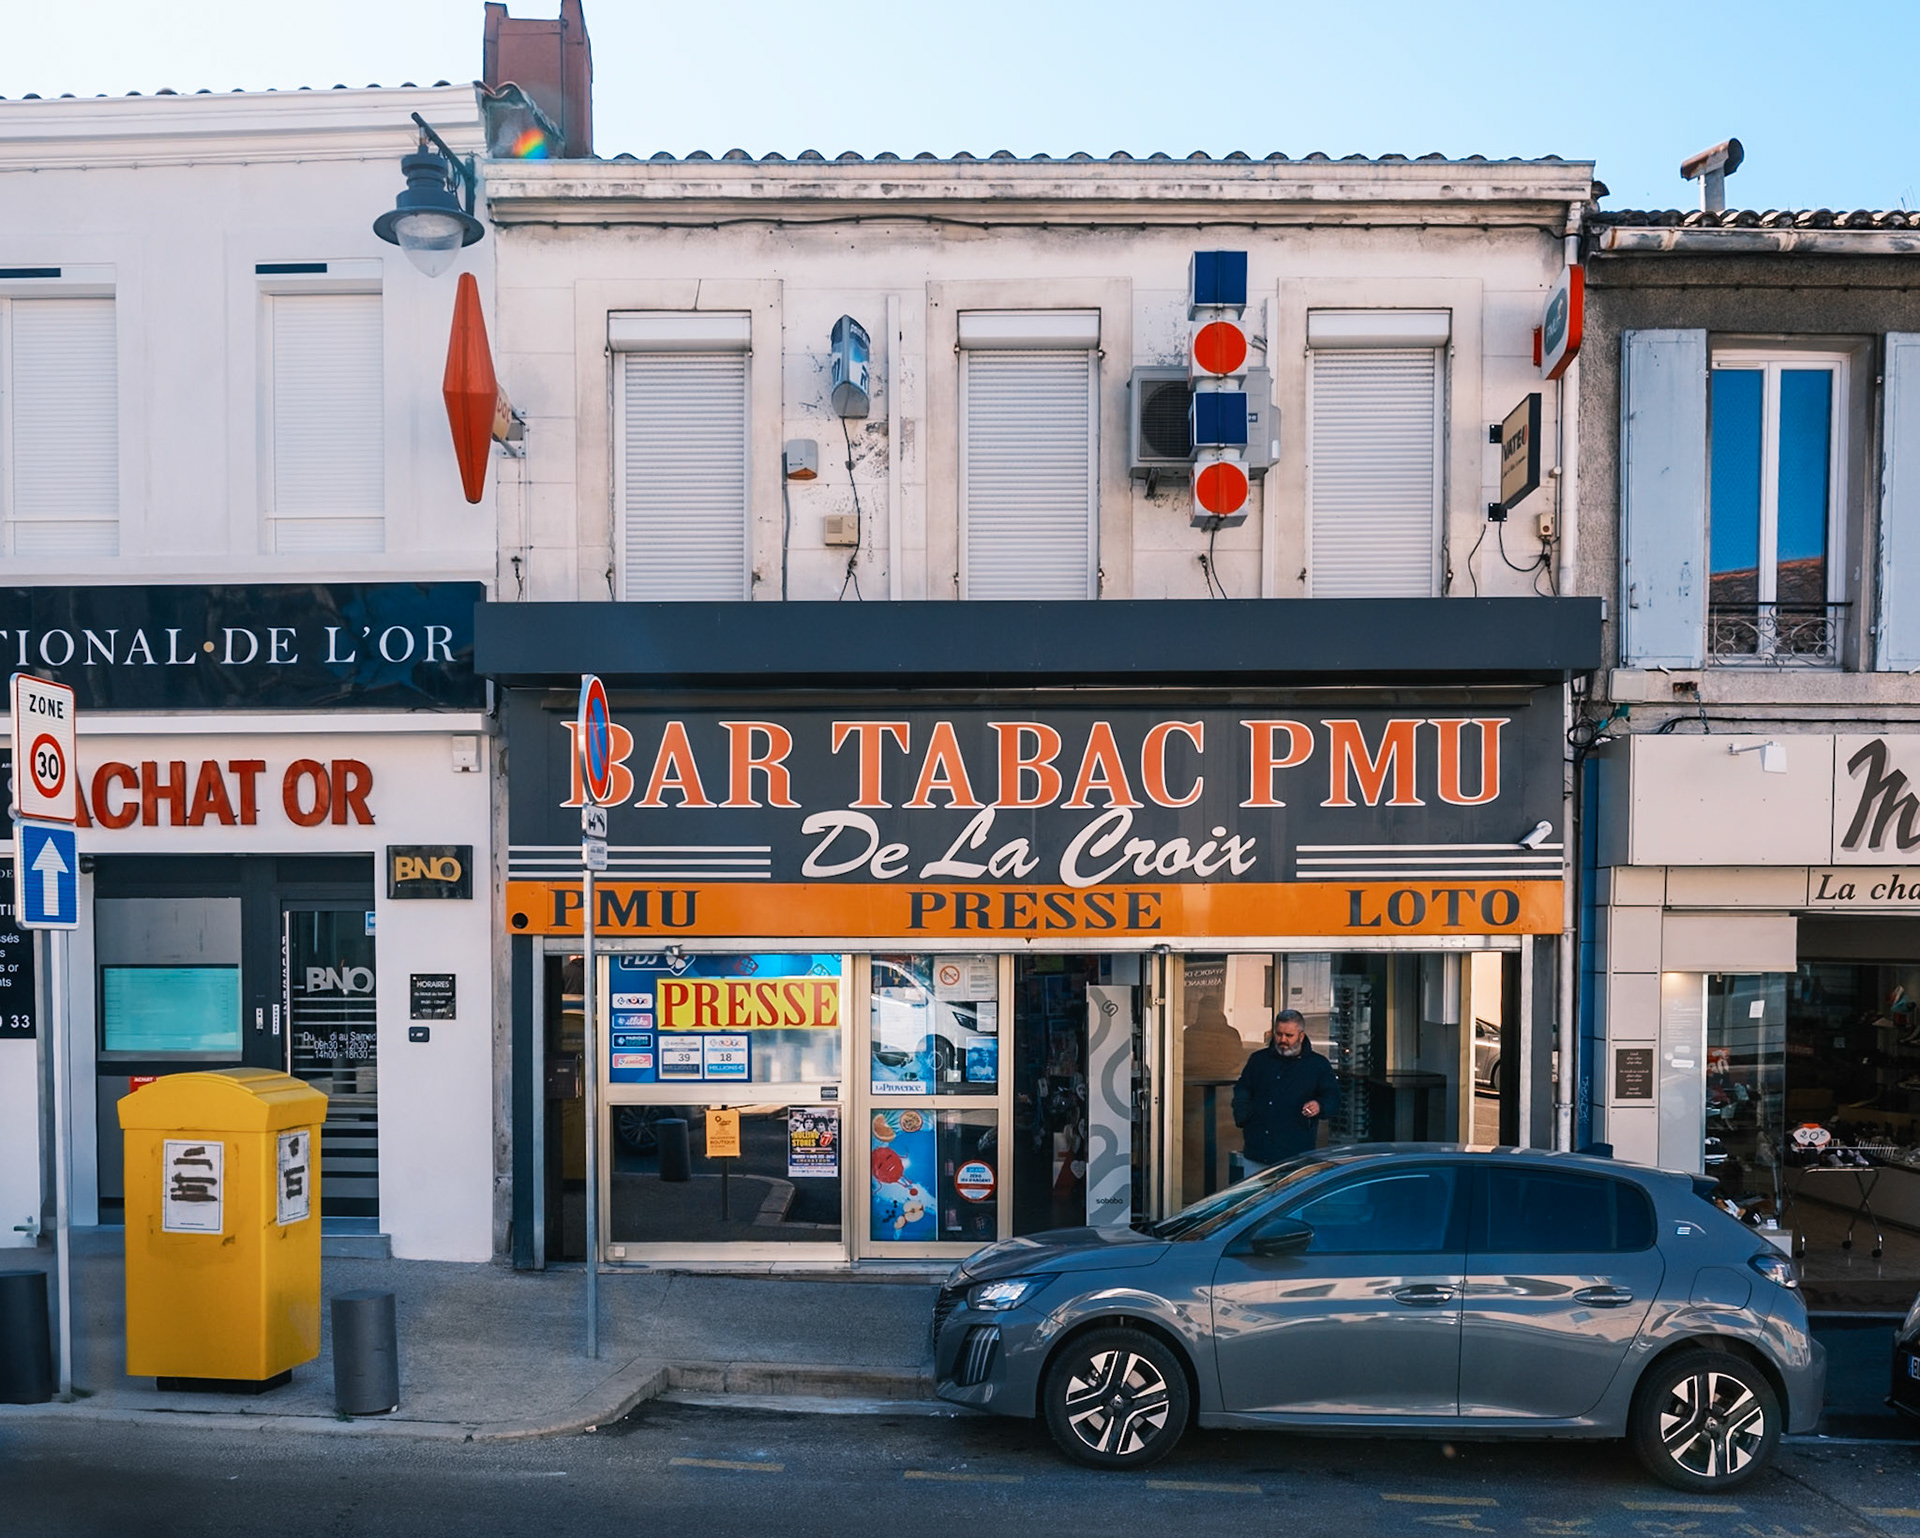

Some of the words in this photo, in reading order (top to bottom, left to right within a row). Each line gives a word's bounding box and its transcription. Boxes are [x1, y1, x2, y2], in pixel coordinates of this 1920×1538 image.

[220, 627, 298, 664] DE
[29, 694, 64, 719] ZONE
[37, 752, 59, 780] 30
[831, 720, 1204, 809] TABAC
[1239, 717, 1511, 809] PMU
[282, 759, 376, 827] OR
[801, 810, 909, 879] De
[919, 805, 1039, 879] La
[1059, 807, 1257, 888] Croix
[395, 856, 462, 882] BNO
[1815, 874, 1856, 900] La
[1870, 873, 1920, 900] cha
[550, 888, 702, 928] PMU
[905, 890, 1162, 930] PRESSE
[1344, 888, 1521, 927] LOTO
[8, 964, 19, 972] or
[306, 967, 375, 994] BNO
[660, 982, 837, 1027] PRESSE
[11, 1015, 30, 1028] 33
[345, 1041, 368, 1050] 12h30
[678, 1053, 691, 1062] 39
[720, 1053, 732, 1062] 18
